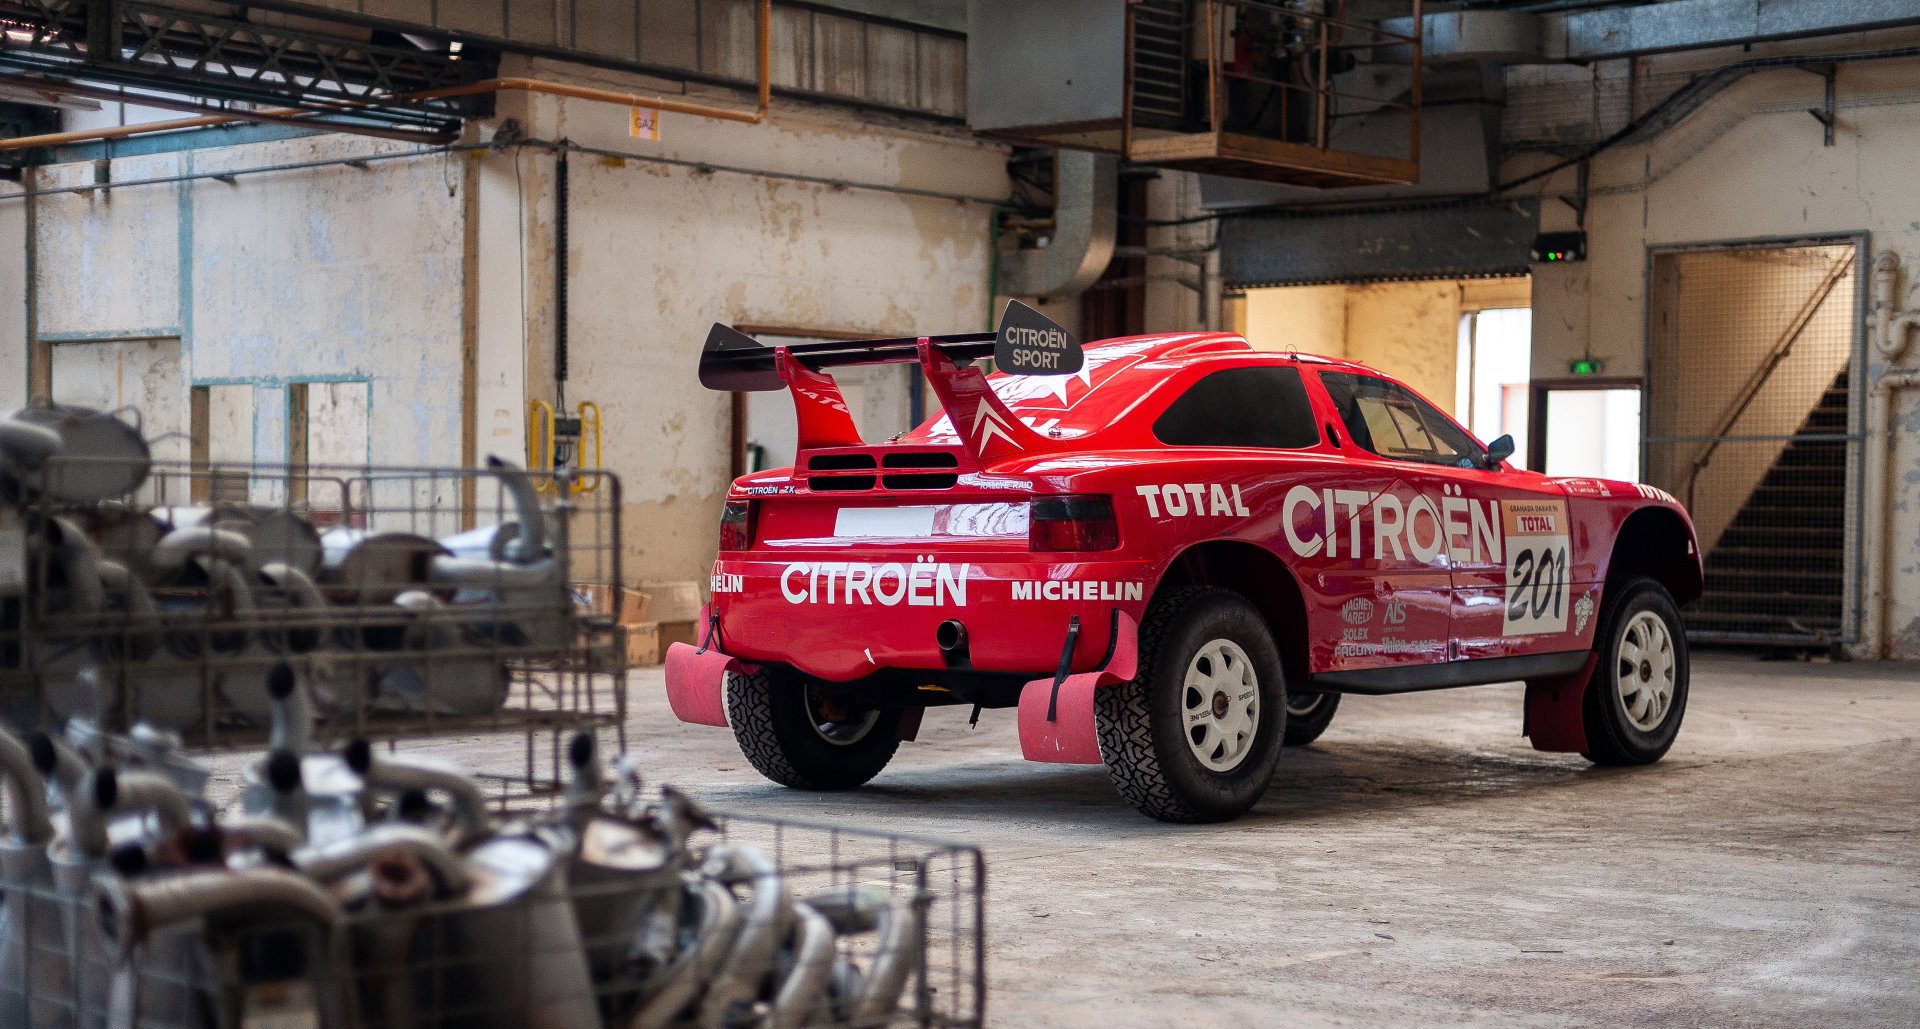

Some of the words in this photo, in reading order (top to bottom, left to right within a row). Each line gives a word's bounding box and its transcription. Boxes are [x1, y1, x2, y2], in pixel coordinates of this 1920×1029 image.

[634, 117, 655, 131] GAZ
[1005, 326, 1067, 350] CITROËN
[1012, 348, 1060, 369] SPORT
[784, 485, 796, 494] ZX
[1135, 483, 1250, 518] TOTAL
[1282, 483, 1502, 564] CITROËN
[1520, 516, 1552, 531] TOTAL
[710, 575, 743, 593] HELIN
[780, 554, 970, 606] CITROËN
[1011, 580, 1143, 601] MICHELIN
[1508, 546, 1565, 621] 201
[1343, 627, 1369, 641] SOLEX
